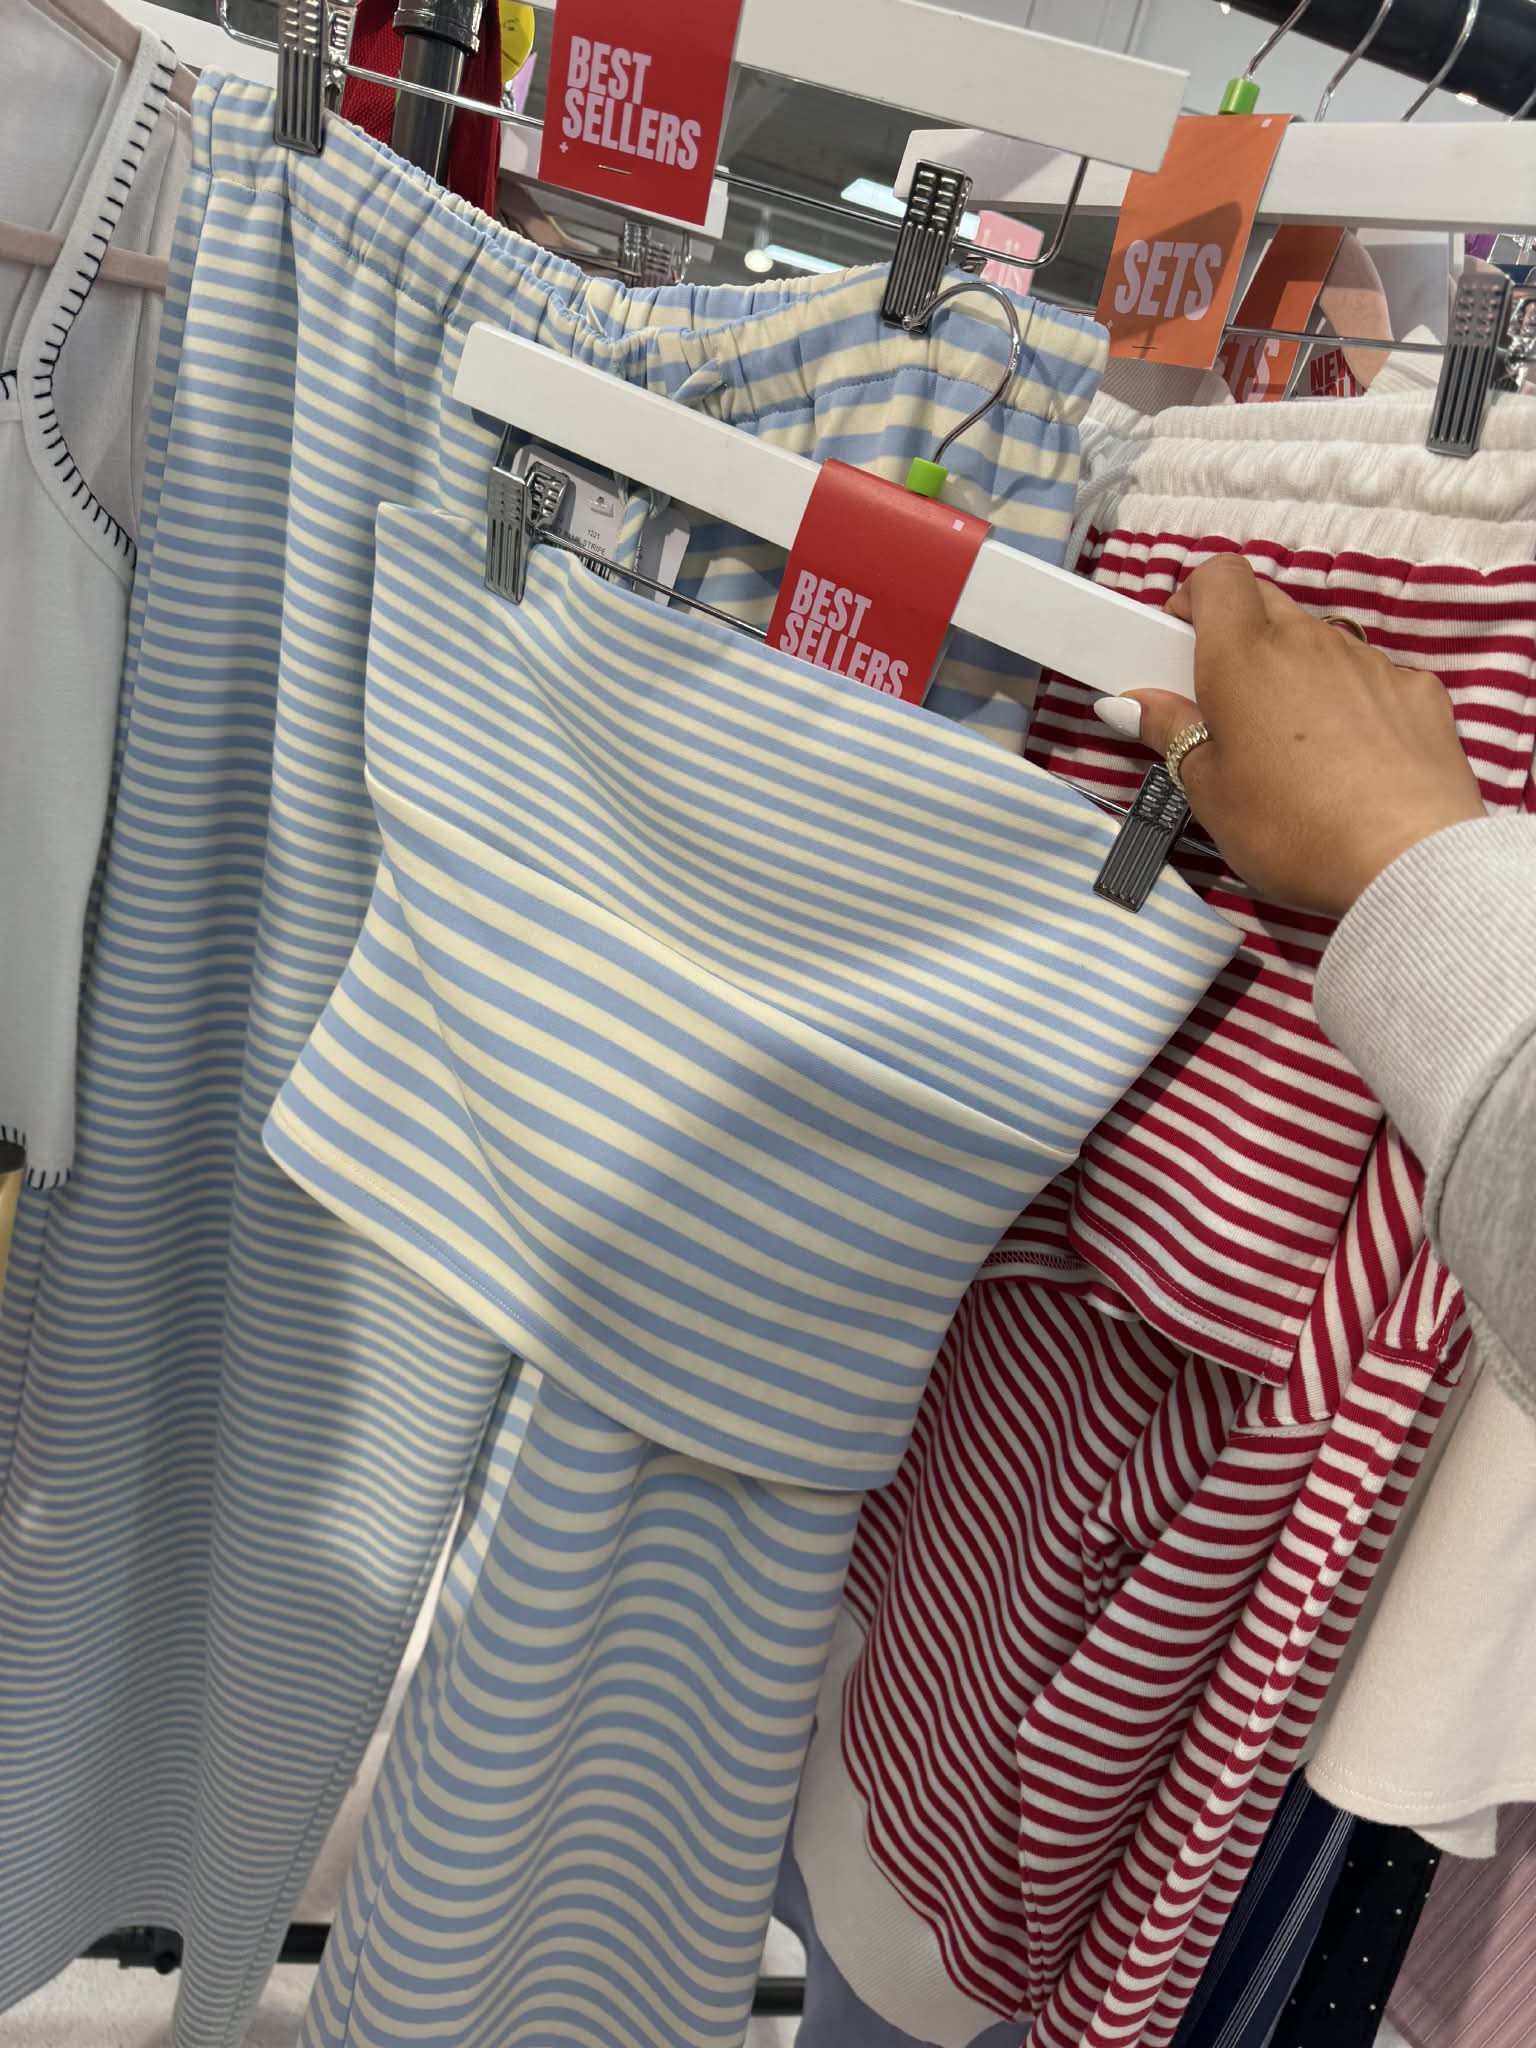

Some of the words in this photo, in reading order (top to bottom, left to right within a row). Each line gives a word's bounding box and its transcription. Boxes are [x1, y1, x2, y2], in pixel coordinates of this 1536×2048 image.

[567, 35, 652, 105] BEST
[562, 88, 701, 170] SELLERS
[1114, 239, 1222, 321] SETS
[583, 539, 606, 556] STRIPE
[790, 569, 872, 639] BEST
[779, 612, 909, 698] SELLERS
